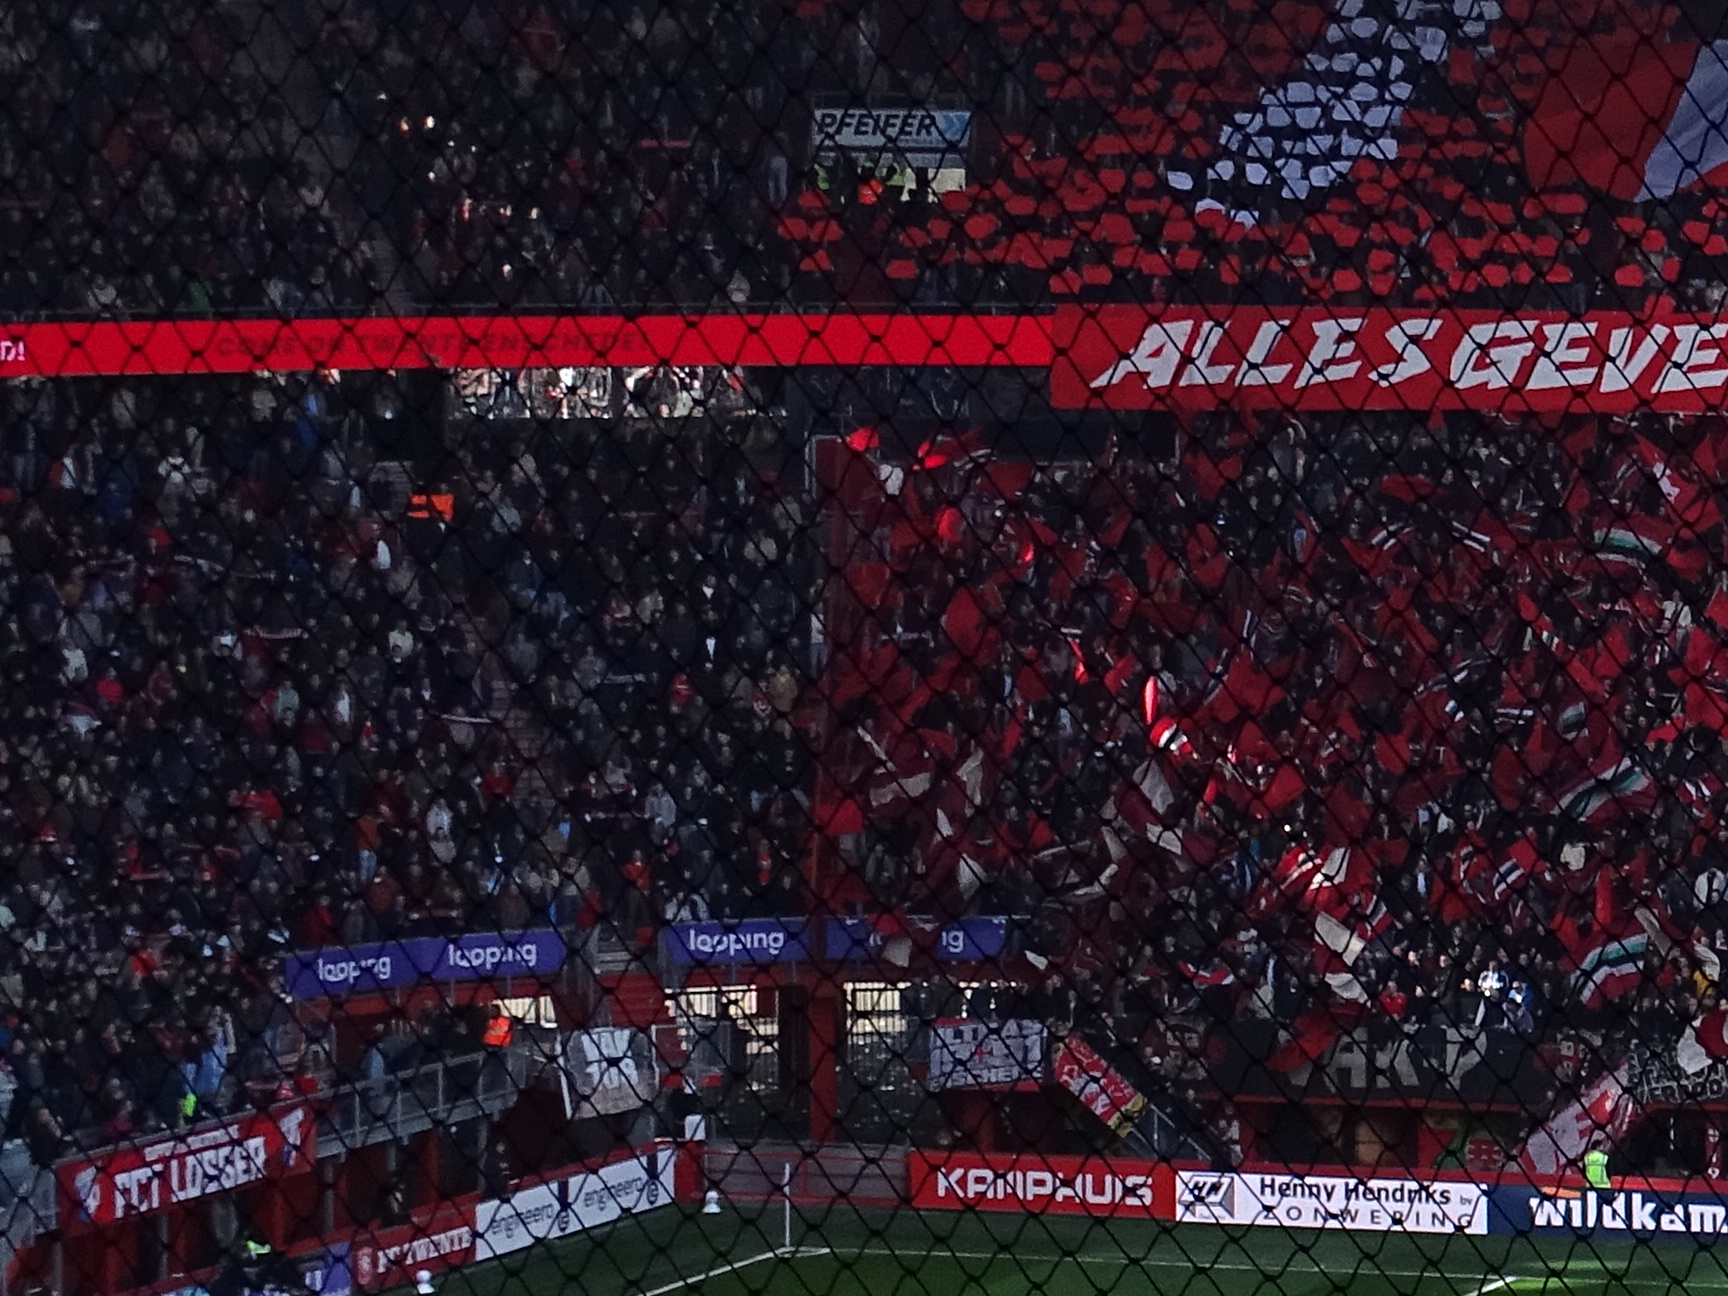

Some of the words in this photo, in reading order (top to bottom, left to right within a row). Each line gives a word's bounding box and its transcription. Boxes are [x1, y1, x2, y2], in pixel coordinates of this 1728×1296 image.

[817, 112, 933, 137] PFEIFER
[1090, 317, 1445, 390] ALLES
[688, 928, 785, 955] looping
[936, 1167, 1154, 1206] KAMPHUIS
[1260, 1176, 1336, 1200] Henny
[1344, 1181, 1451, 1205] Hendriks
[1263, 1204, 1473, 1231] ZONWERING
